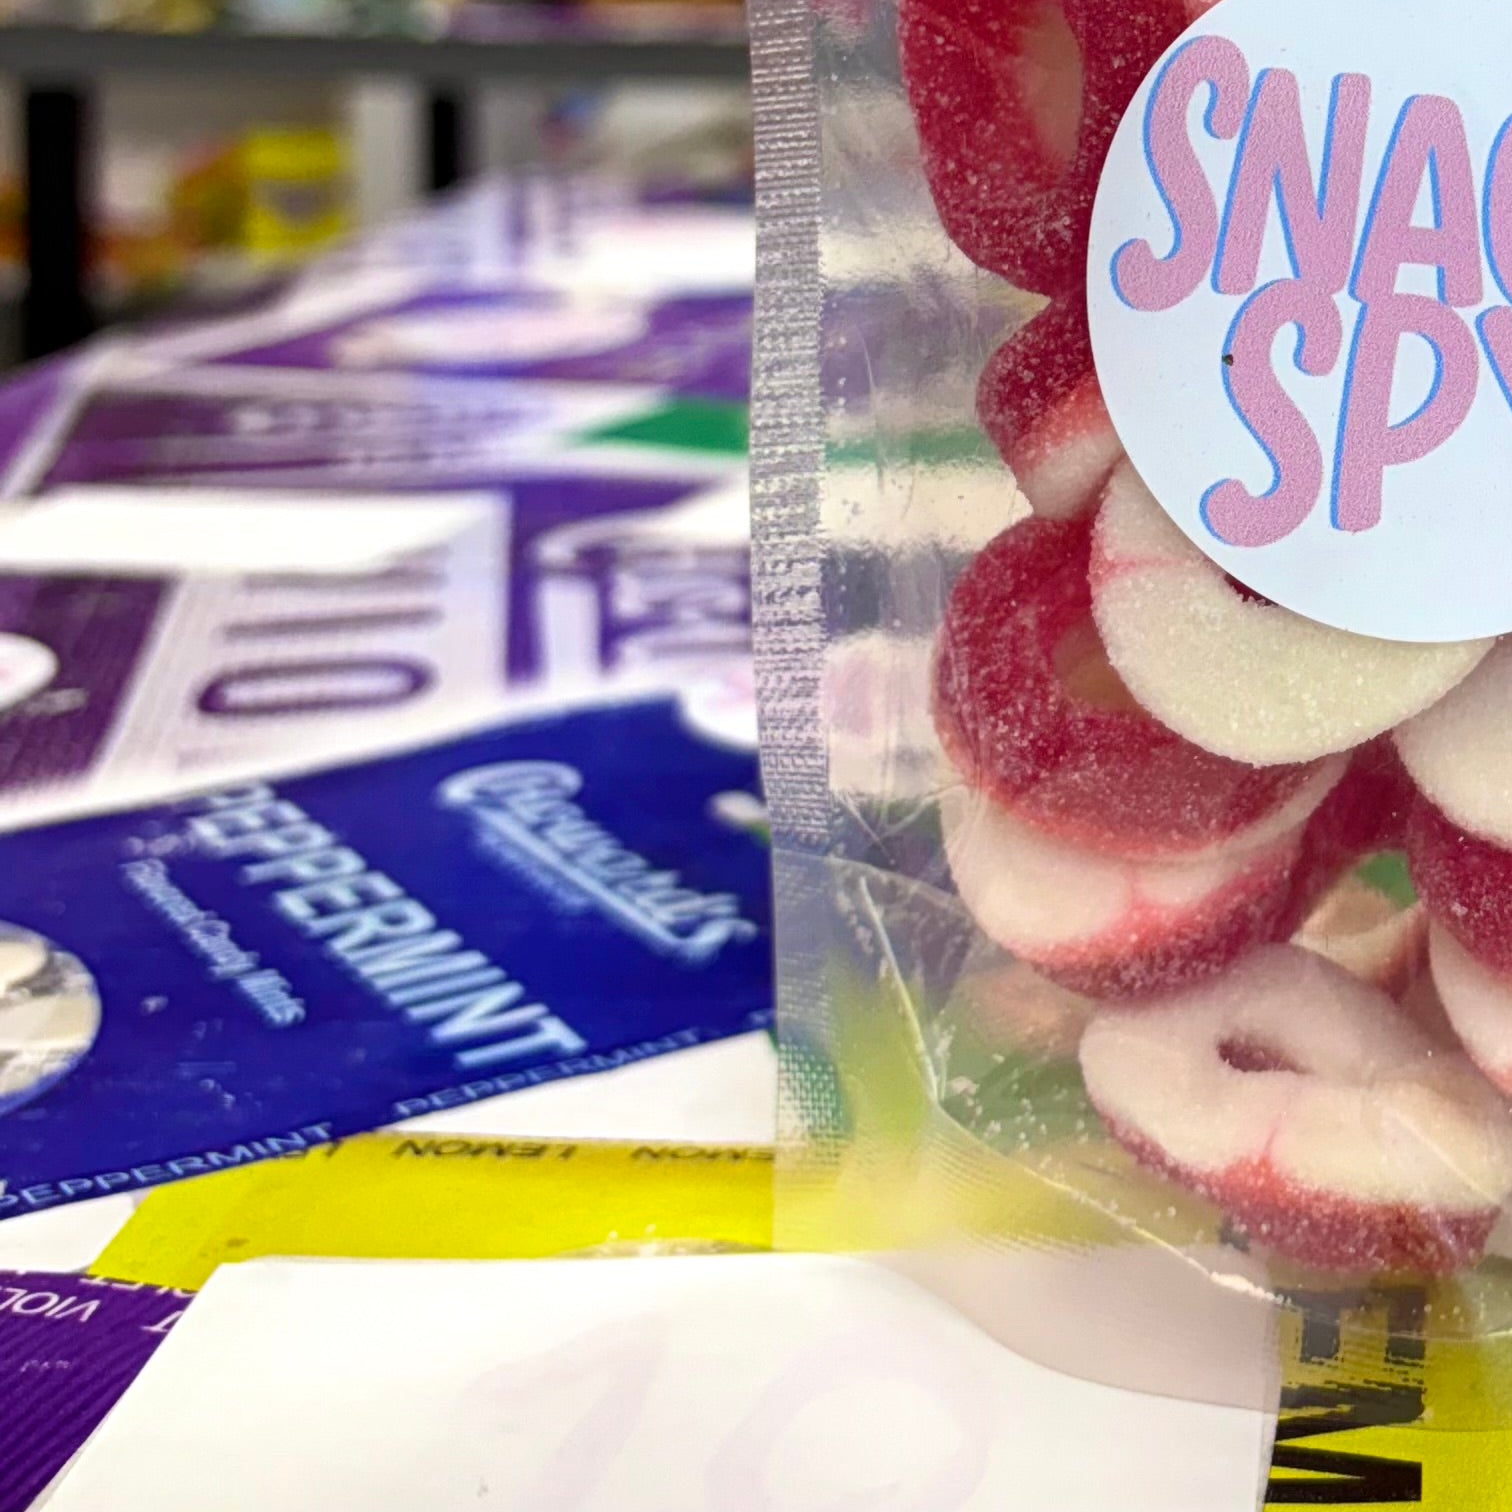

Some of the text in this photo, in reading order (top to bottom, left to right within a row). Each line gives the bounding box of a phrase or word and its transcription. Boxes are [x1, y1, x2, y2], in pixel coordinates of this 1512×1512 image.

[190, 781, 588, 1068] PEPPERMINT
[394, 1138, 773, 1164] EMON LEMON
[0, 1284, 102, 1323] VIOL
